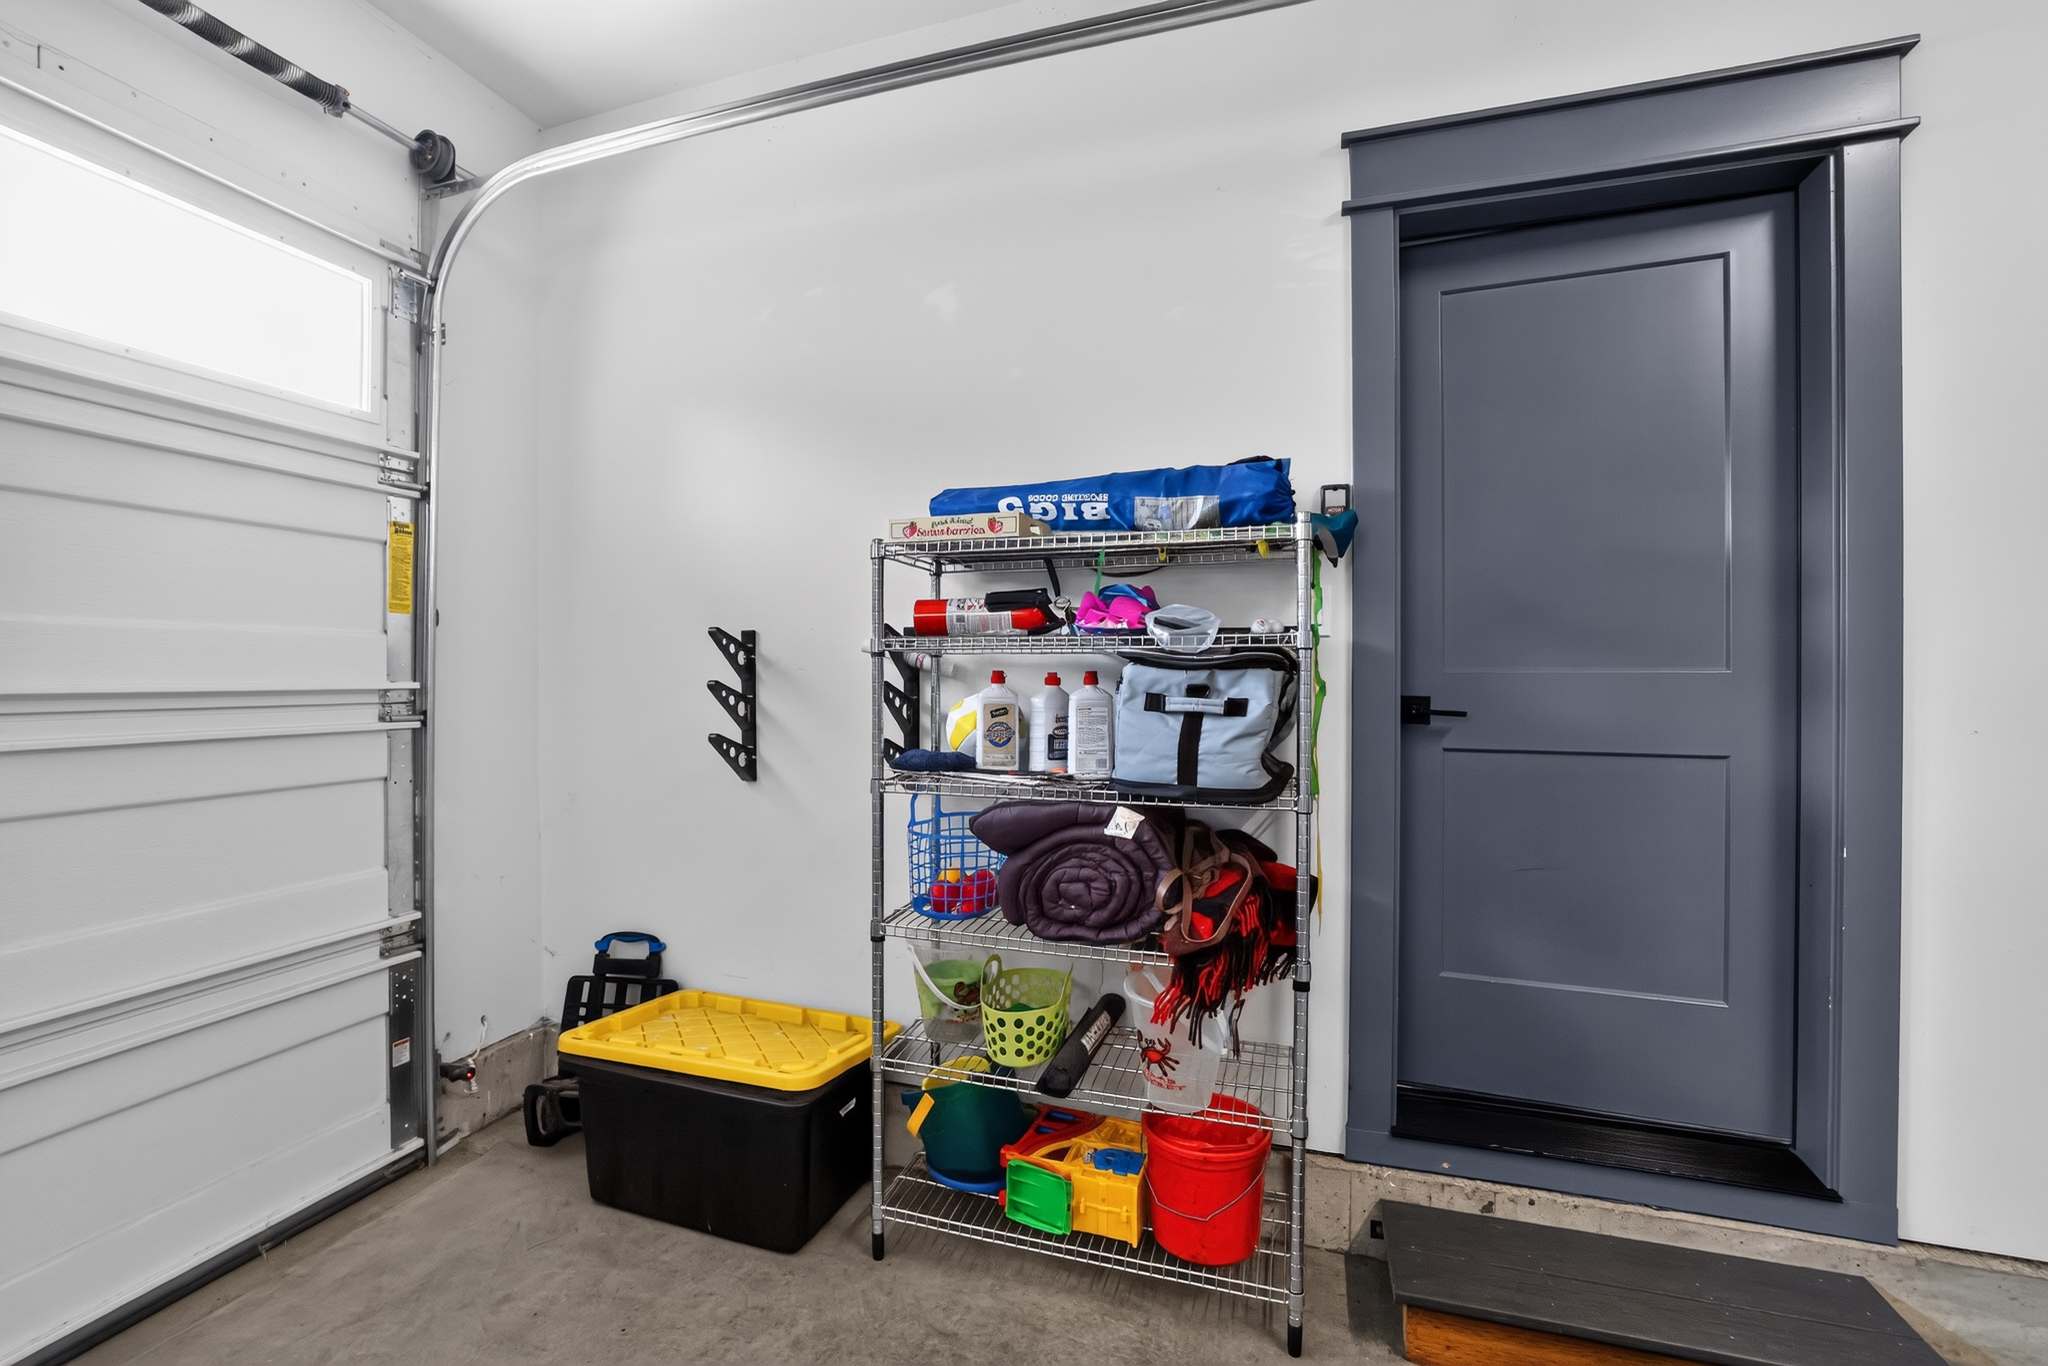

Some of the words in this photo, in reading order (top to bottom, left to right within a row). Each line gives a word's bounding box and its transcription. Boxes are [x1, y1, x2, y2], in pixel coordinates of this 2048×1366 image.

[998, 496, 1025, 514] 5
[1028, 494, 1059, 502] GOODS
[1029, 501, 1110, 520] BIG
